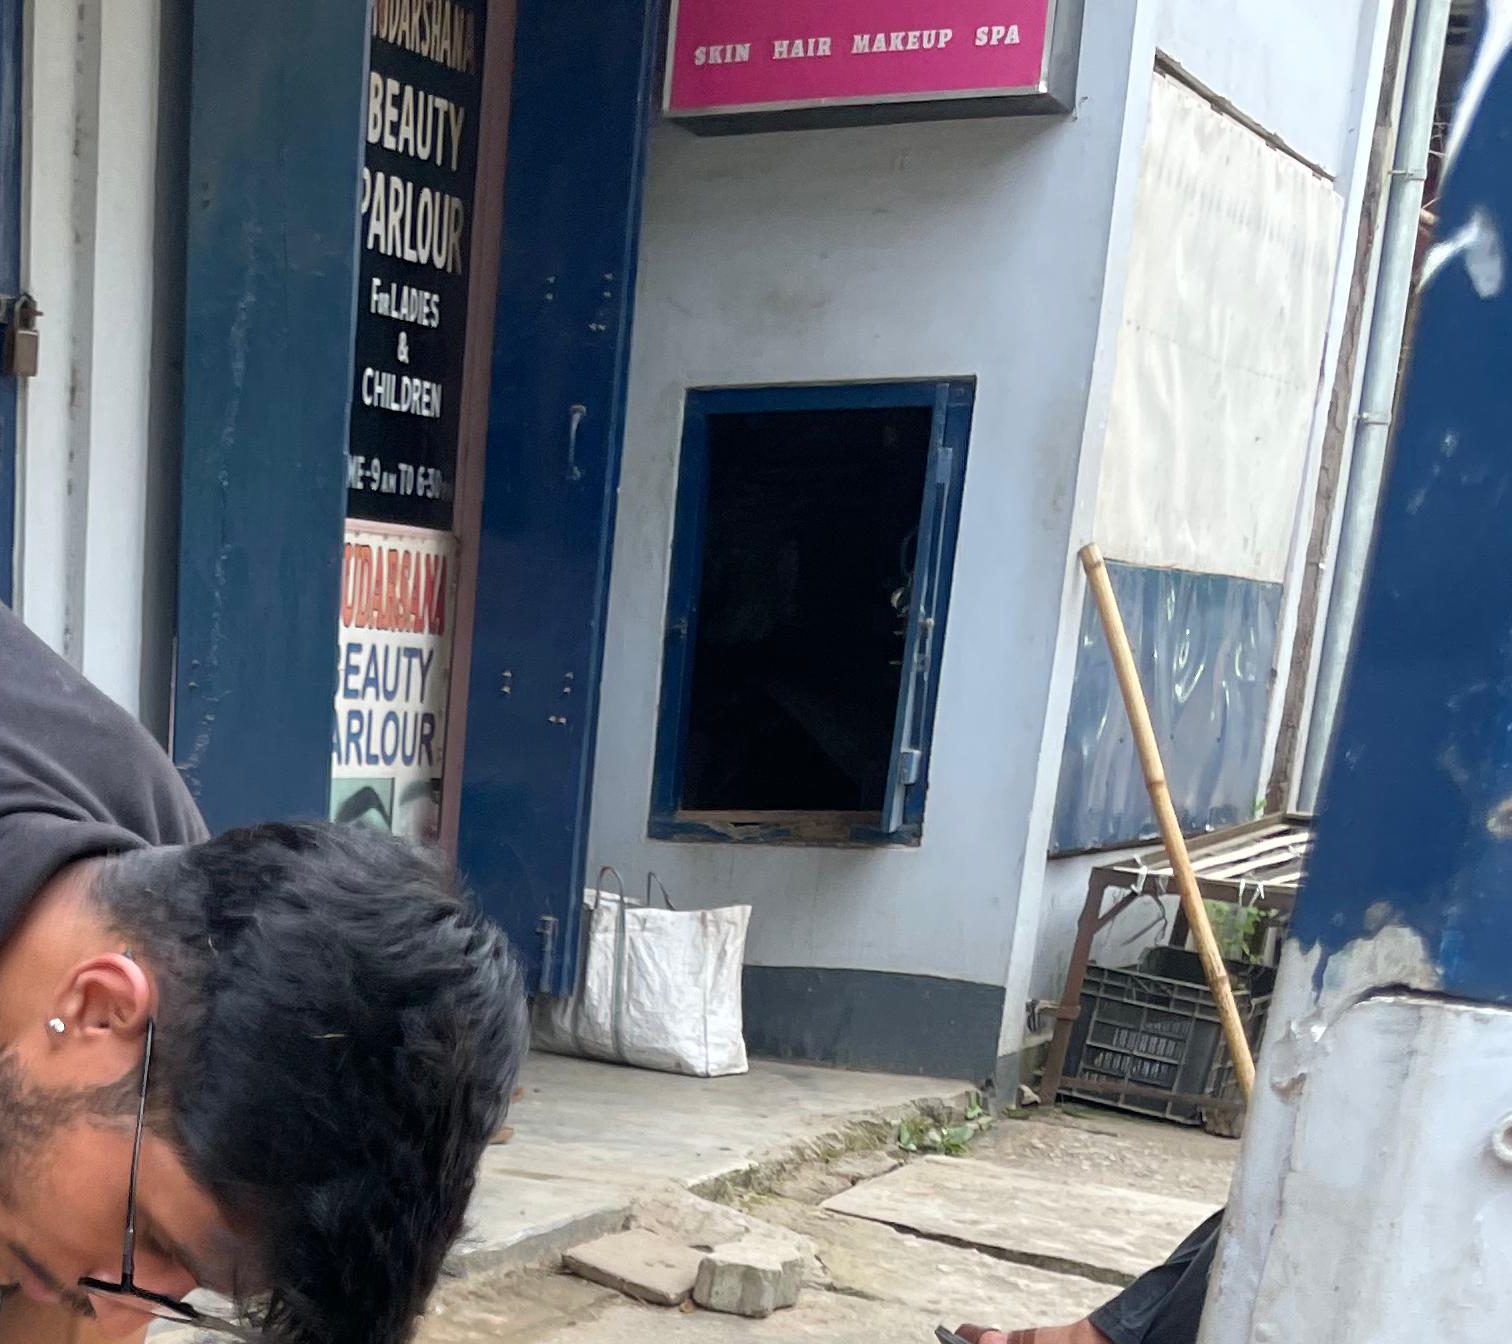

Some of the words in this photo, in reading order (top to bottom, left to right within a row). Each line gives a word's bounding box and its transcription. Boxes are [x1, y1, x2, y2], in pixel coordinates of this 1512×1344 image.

[694, 43, 751, 66] SKIN
[772, 37, 831, 60] HAIR
[851, 28, 953, 54] MAKEUP
[975, 24, 1020, 46] SPA
[367, 71, 464, 172] BEAUTY
[397, 331, 409, 364] &
[362, 367, 442, 418] CHILDREN
[339, 642, 435, 704] EAUTY
